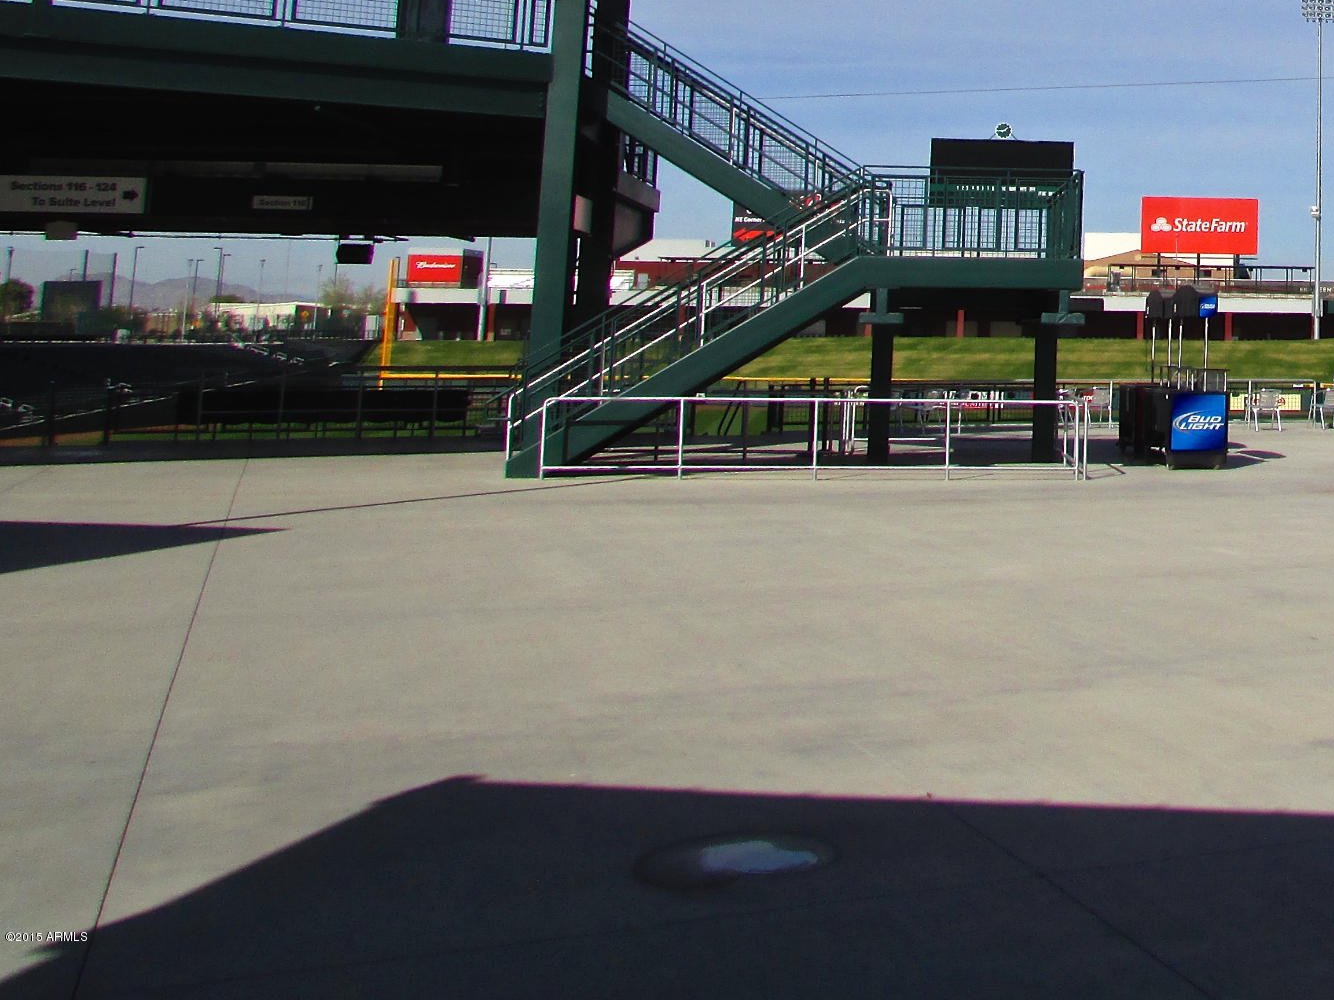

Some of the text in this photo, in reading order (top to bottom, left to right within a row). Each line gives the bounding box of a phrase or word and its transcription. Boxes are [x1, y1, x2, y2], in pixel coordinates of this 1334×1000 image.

[10, 181, 63, 192] Sections
[66, 182, 88, 192] 116
[95, 182, 118, 192] 124
[32, 196, 117, 207] To Suite Level
[1187, 415, 1222, 423] BUD
[1179, 422, 1225, 430] LIGHT
